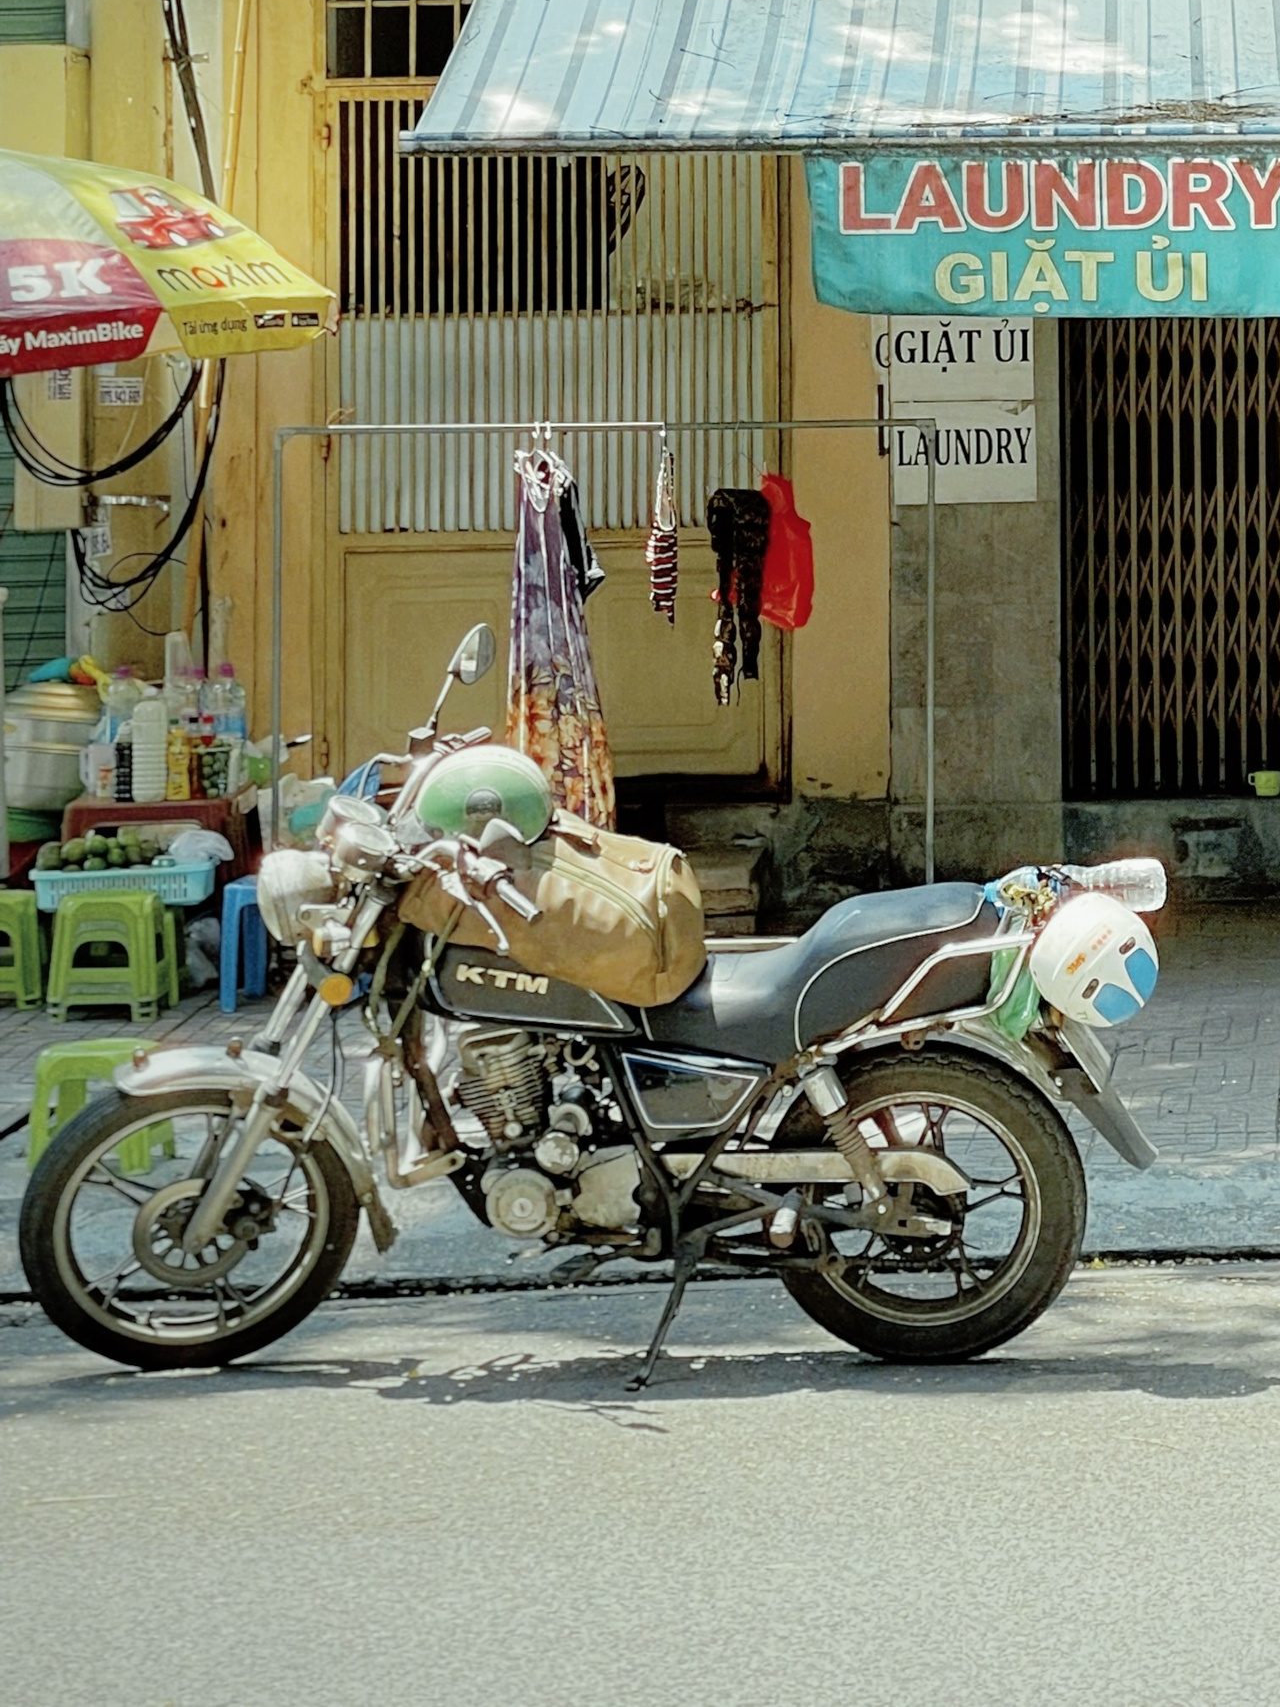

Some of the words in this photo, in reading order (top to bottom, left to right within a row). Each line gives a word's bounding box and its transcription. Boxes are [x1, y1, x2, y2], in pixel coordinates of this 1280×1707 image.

[7, 257, 112, 302] 5K
[157, 255, 293, 292] maxim
[935, 238, 1115, 313] GIẶT
[1136, 235, 1208, 302] ỦI
[24, 320, 144, 351] MaximBike
[894, 320, 982, 373] GIẶT
[993, 319, 1031, 362] ỦI
[898, 427, 1033, 466] LAUNDRY
[456, 963, 549, 995] KTM
